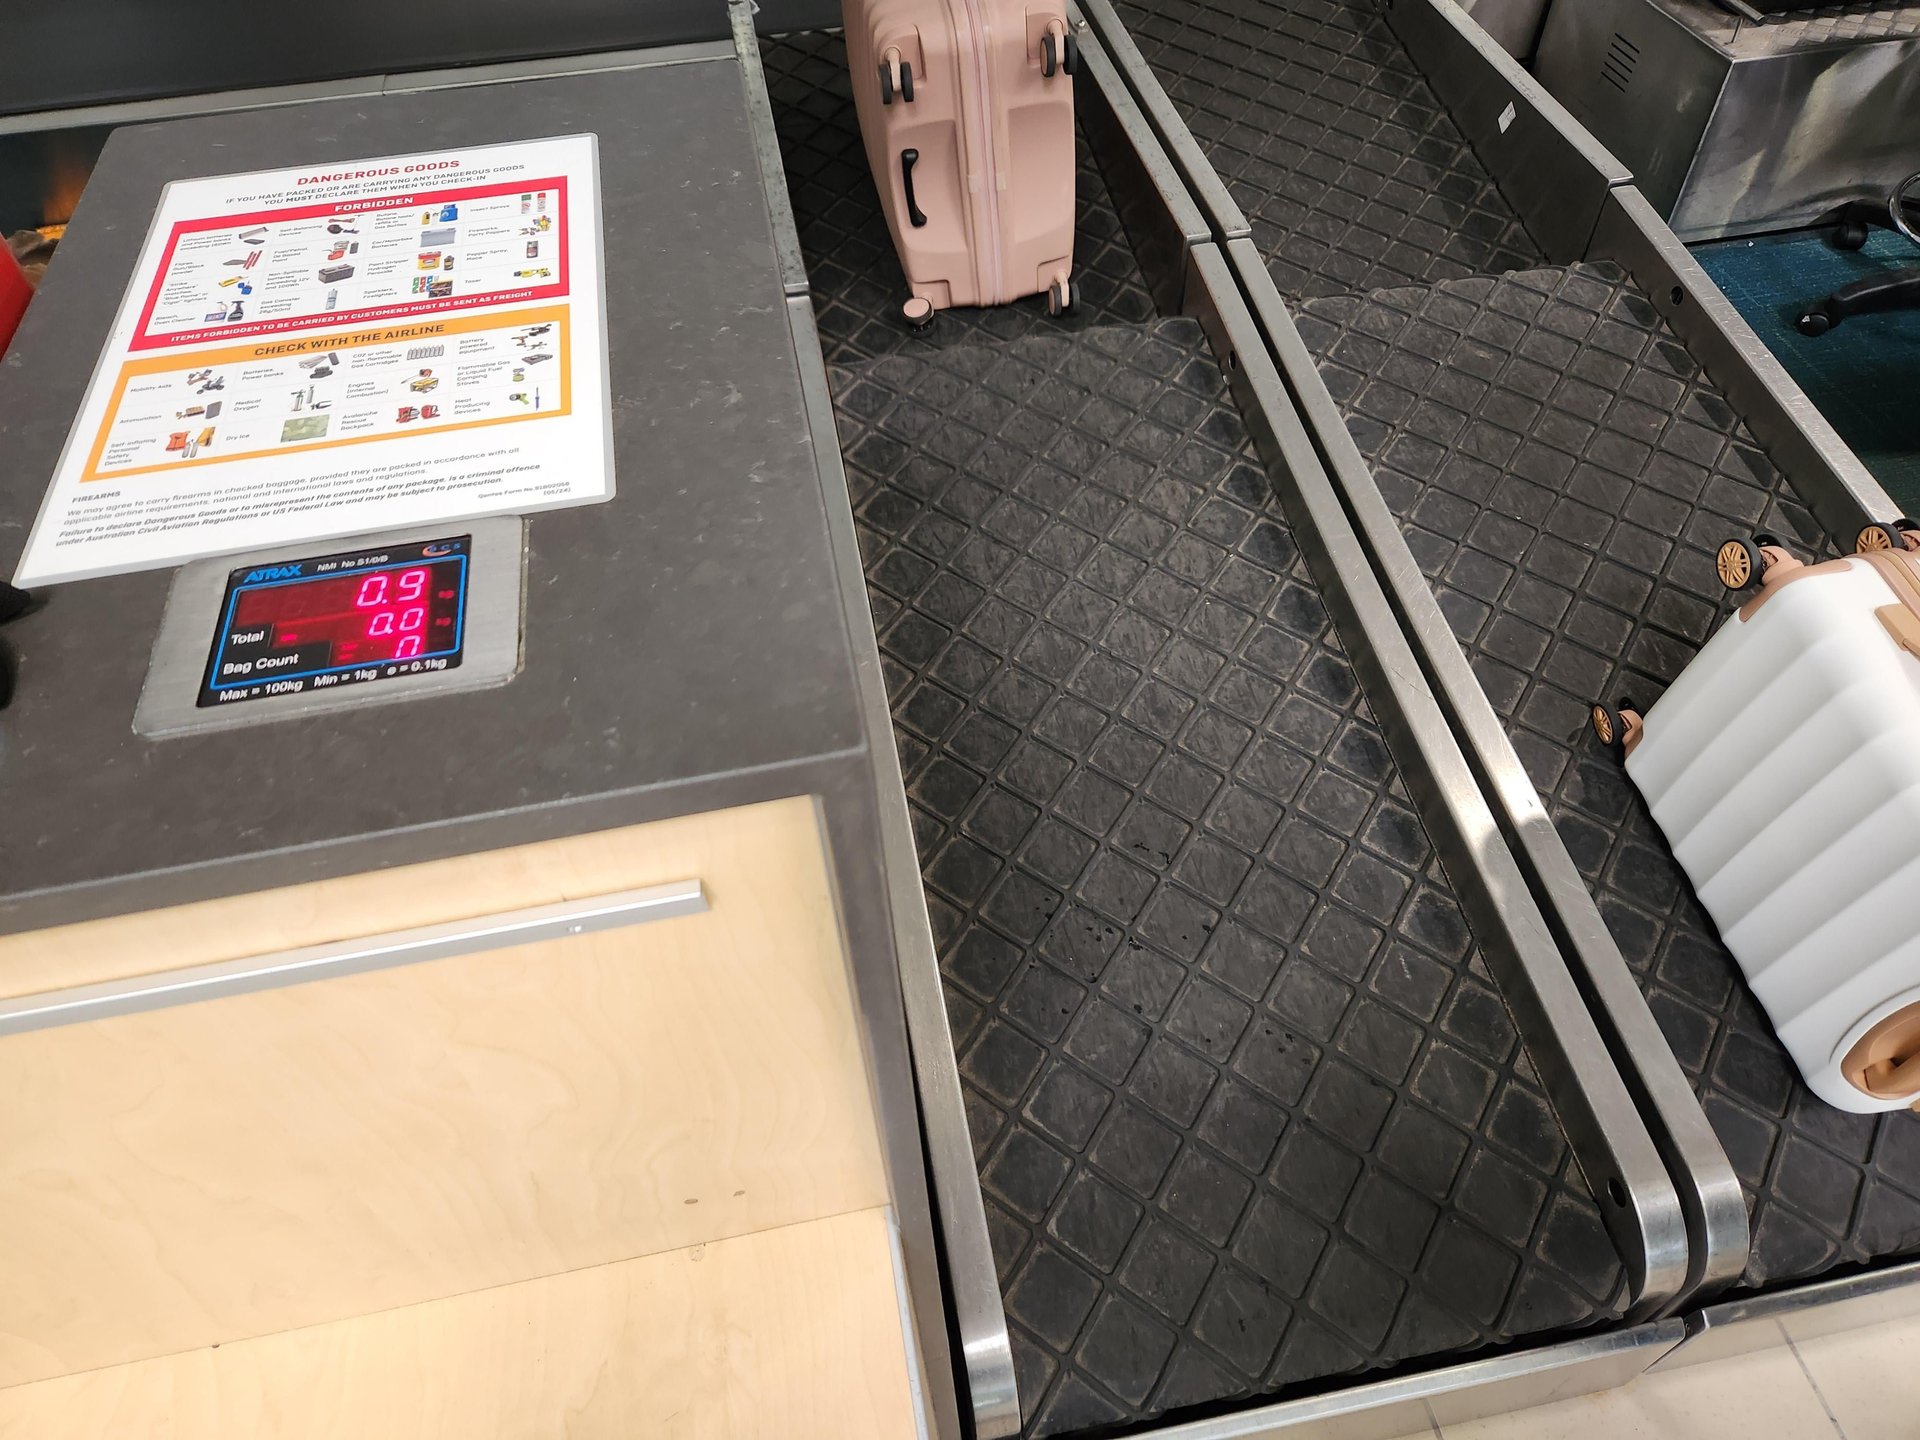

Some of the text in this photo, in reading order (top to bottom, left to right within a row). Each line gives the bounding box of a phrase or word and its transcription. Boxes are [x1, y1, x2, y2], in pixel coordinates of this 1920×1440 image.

[286, 188, 324, 196] PACKED
[363, 178, 410, 187] CARRYING
[434, 169, 490, 179] DANGEROUS
[297, 161, 459, 185] DANGEROUS GOODS
[315, 190, 359, 199] DECLARE
[441, 175, 486, 184] CHECK-IN
[335, 197, 413, 212] FORBIDDEN
[171, 333, 201, 342] ITEMS
[203, 326, 260, 337] FORBIDDEN
[292, 316, 335, 326] CARRIED
[351, 307, 409, 319] CUSTOMERS
[411, 303, 437, 311] MUST
[493, 291, 532, 300] FREIGHT
[255, 324, 444, 356] CHECK WITH THE AIRLINE
[459, 342, 488, 350] powered
[459, 346, 495, 354] equipment
[365, 359, 399, 367] Cartridges
[342, 411, 378, 419] Avalanche
[454, 401, 490, 409] Producing
[341, 422, 374, 431] Backpack
[108, 446, 140, 454] Personal
[106, 503, 132, 511] agree
[146, 497, 170, 505] carry
[172, 492, 211, 501] firearms
[224, 483, 264, 494] checked
[266, 479, 308, 488] baggage,
[310, 471, 349, 483] provided
[389, 461, 421, 472] packed
[434, 453, 486, 464] accordance
[59, 528, 93, 537] Failure
[106, 521, 142, 530] declare
[144, 513, 196, 525] Dangerous
[198, 508, 227, 517] Goods
[252, 496, 315, 510] misrepresent
[333, 488, 374, 498] contents
[405, 478, 446, 489] package,
[467, 468, 505, 479] criminal
[506, 465, 540, 473] offence
[64, 513, 112, 525] applicable
[114, 509, 143, 518] airline
[145, 500, 211, 513] requirements,
[213, 493, 251, 503] national
[253, 490, 271, 498] and
[273, 482, 331, 495] international
[375, 469, 427, 480] regulations.
[72, 491, 120, 503] FIREARMS
[56, 538, 84, 547] under
[85, 530, 136, 542] Australian
[137, 526, 160, 534] Civil
[160, 521, 200, 531] Aviation
[202, 513, 258, 525] Regulations
[288, 502, 323, 513] Federal
[345, 496, 364, 504] and
[401, 487, 435, 496] subject
[446, 478, 503, 491] prosecution.
[243, 564, 303, 583] ATRAX
[317, 560, 355, 572] NMI No
[356, 570, 426, 606] 0.9
[369, 607, 424, 636] 0.0
[231, 631, 264, 645] Total
[223, 653, 299, 675] Bag Count
[220, 689, 248, 701] Max
[265, 680, 303, 694] 100kg
[314, 674, 338, 687] Min
[354, 669, 377, 681] 1kg
[411, 658, 447, 672] 0.1kg
